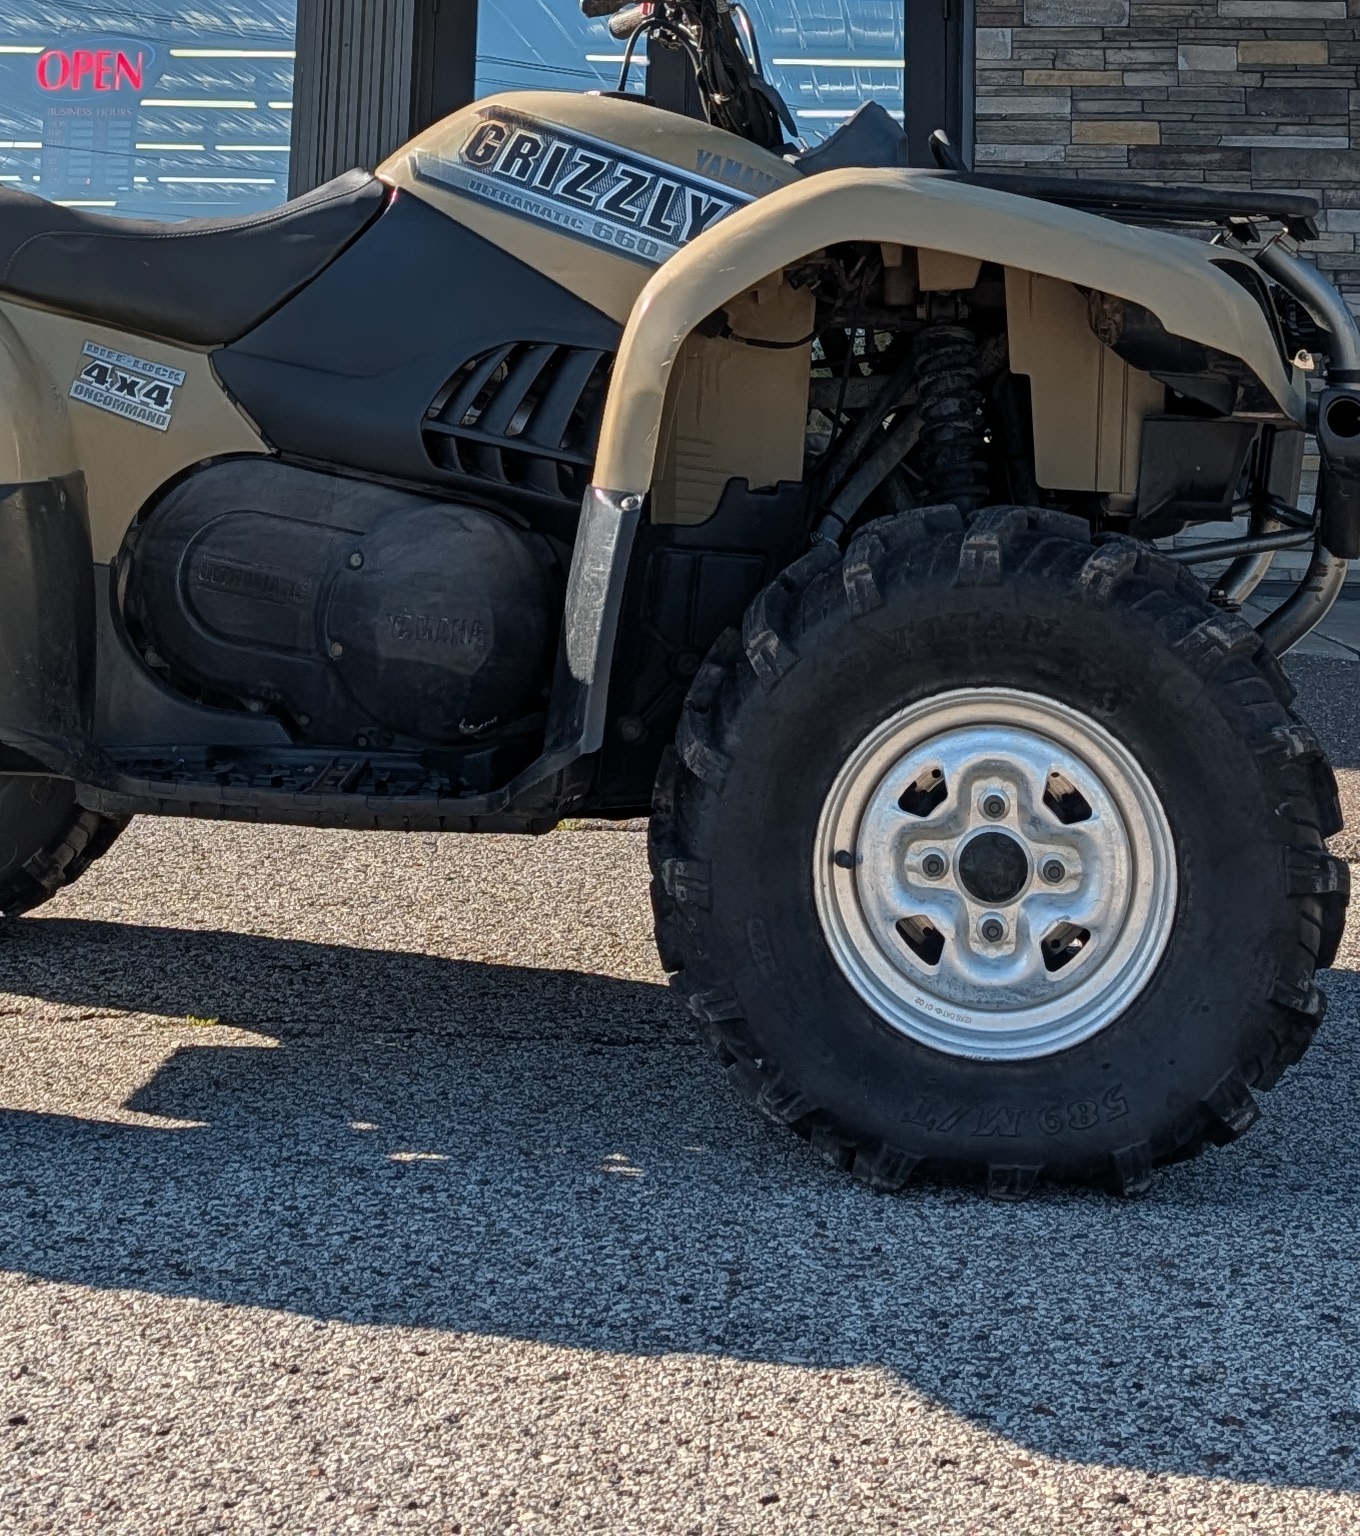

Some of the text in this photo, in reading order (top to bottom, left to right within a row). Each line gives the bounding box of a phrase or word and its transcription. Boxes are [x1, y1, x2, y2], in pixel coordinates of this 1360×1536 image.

[37, 49, 144, 91] OPEN
[459, 118, 735, 247] GRIZZLY
[468, 179, 584, 231] ULTRAMATIC
[591, 219, 659, 257] 660
[86, 344, 182, 382] DIFF-LOCK
[73, 384, 168, 426] ONCOMMAND
